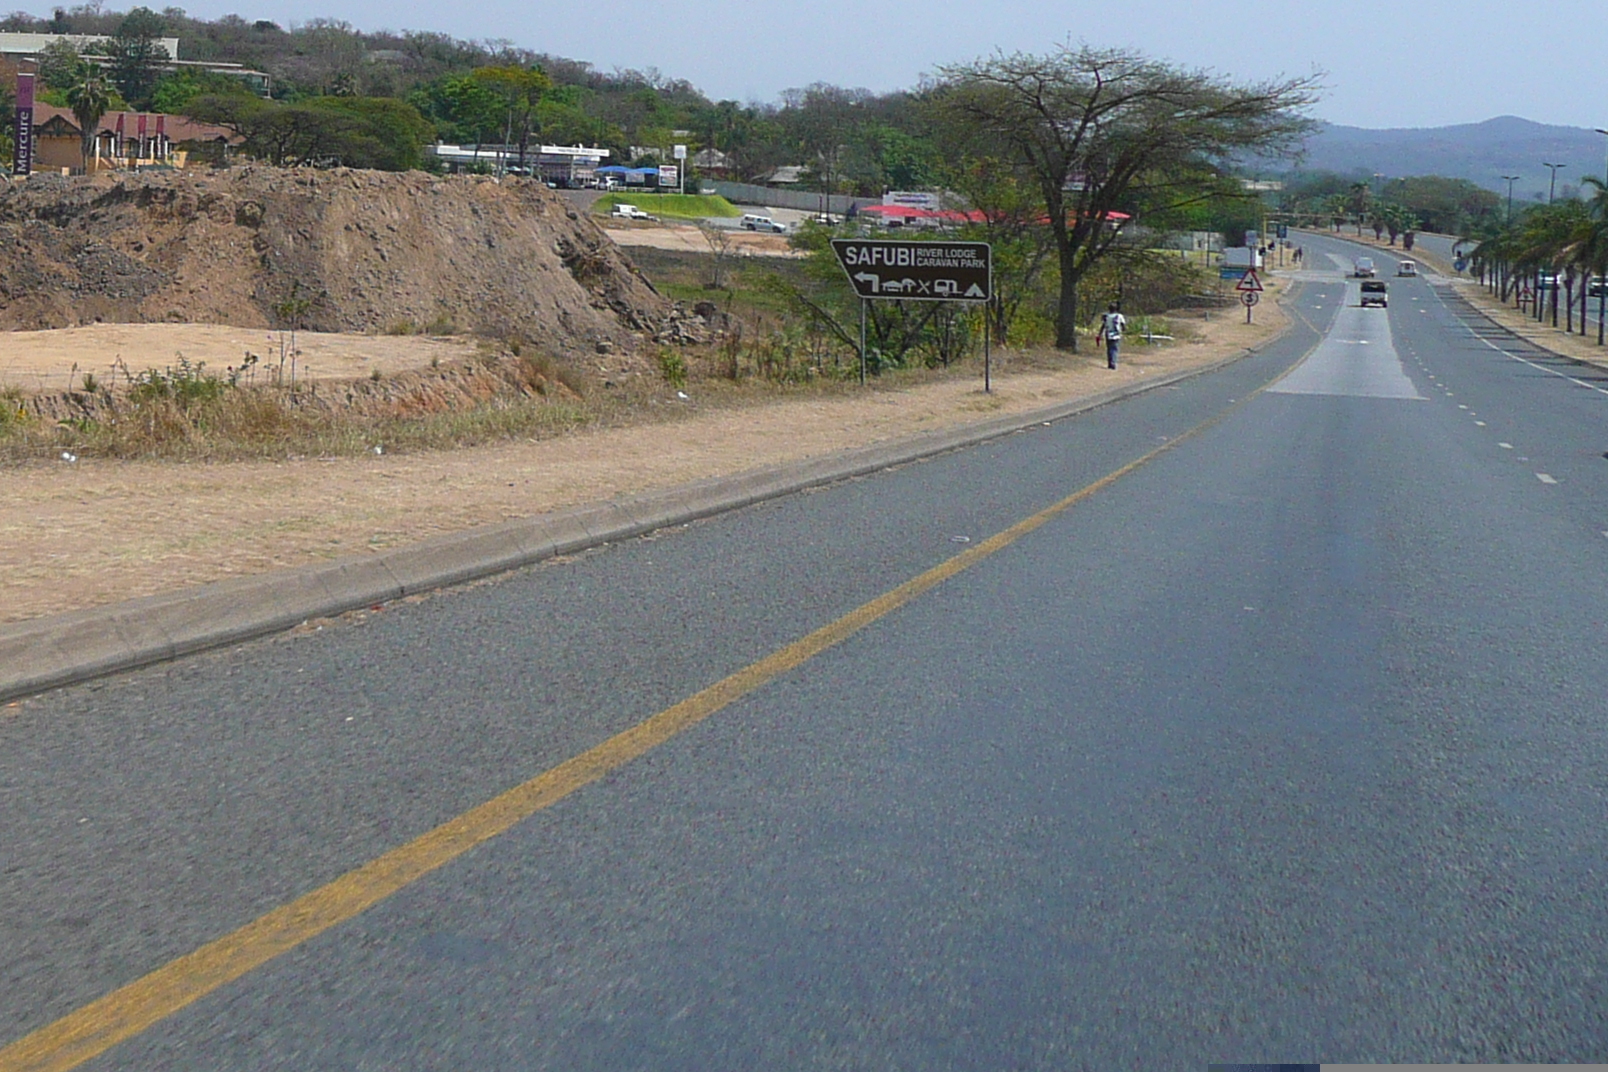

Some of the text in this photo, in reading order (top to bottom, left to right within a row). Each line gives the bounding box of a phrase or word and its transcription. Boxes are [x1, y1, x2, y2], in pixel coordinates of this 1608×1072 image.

[17, 111, 29, 171] Mercure
[845, 246, 915, 266] SAFUBI
[916, 248, 977, 258] RIVER LODGE
[916, 258, 986, 268] CARAVAN PARK
